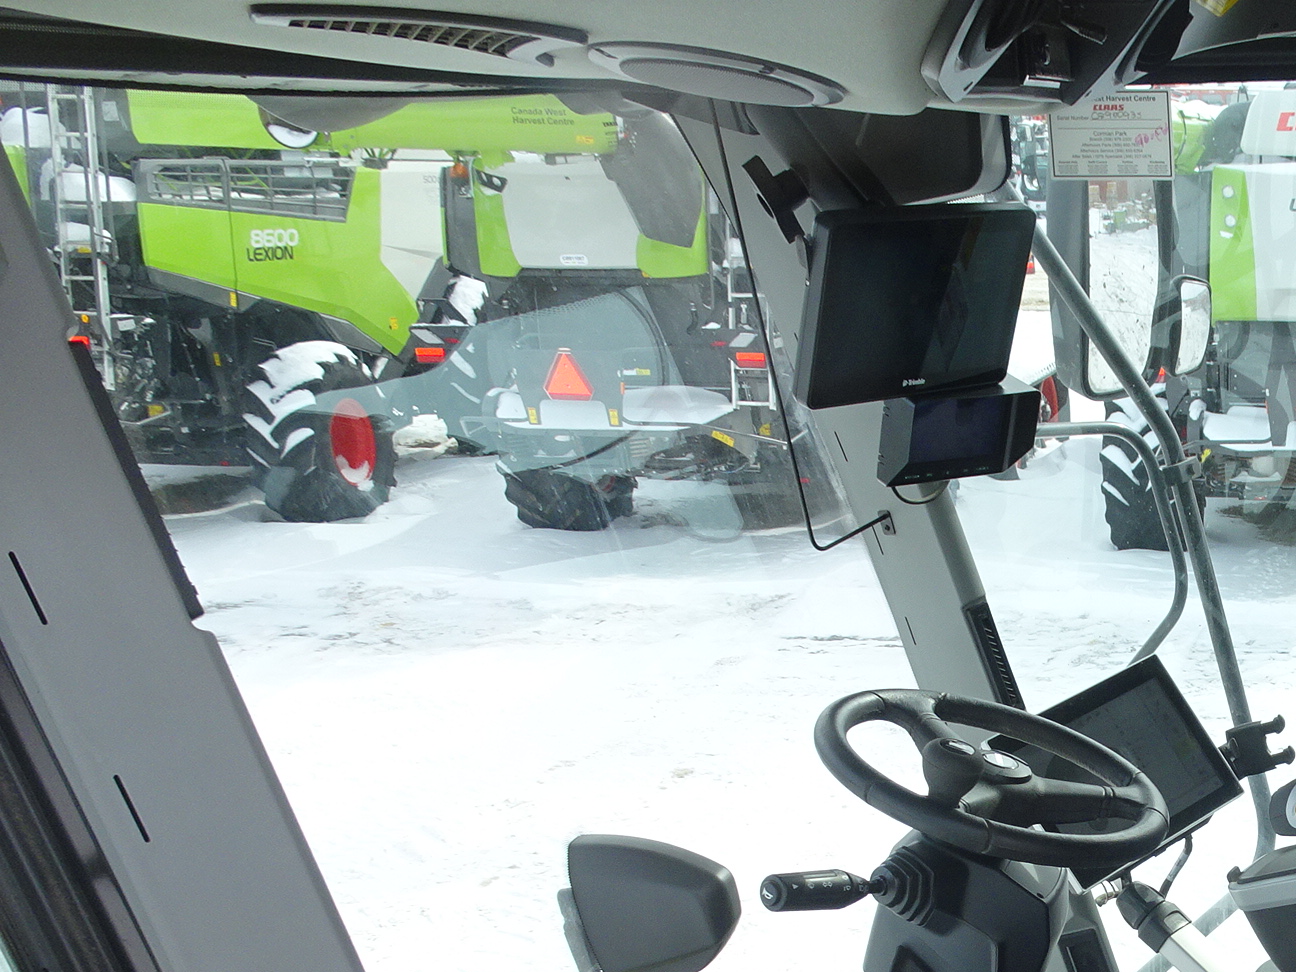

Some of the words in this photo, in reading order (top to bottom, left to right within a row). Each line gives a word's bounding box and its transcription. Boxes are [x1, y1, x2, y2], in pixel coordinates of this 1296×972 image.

[511, 106, 543, 115] Canada
[545, 107, 566, 116] West
[512, 116, 545, 125] Harvest
[548, 117, 575, 125] Centre
[250, 228, 299, 248] 8600
[246, 246, 294, 262] LEXION
